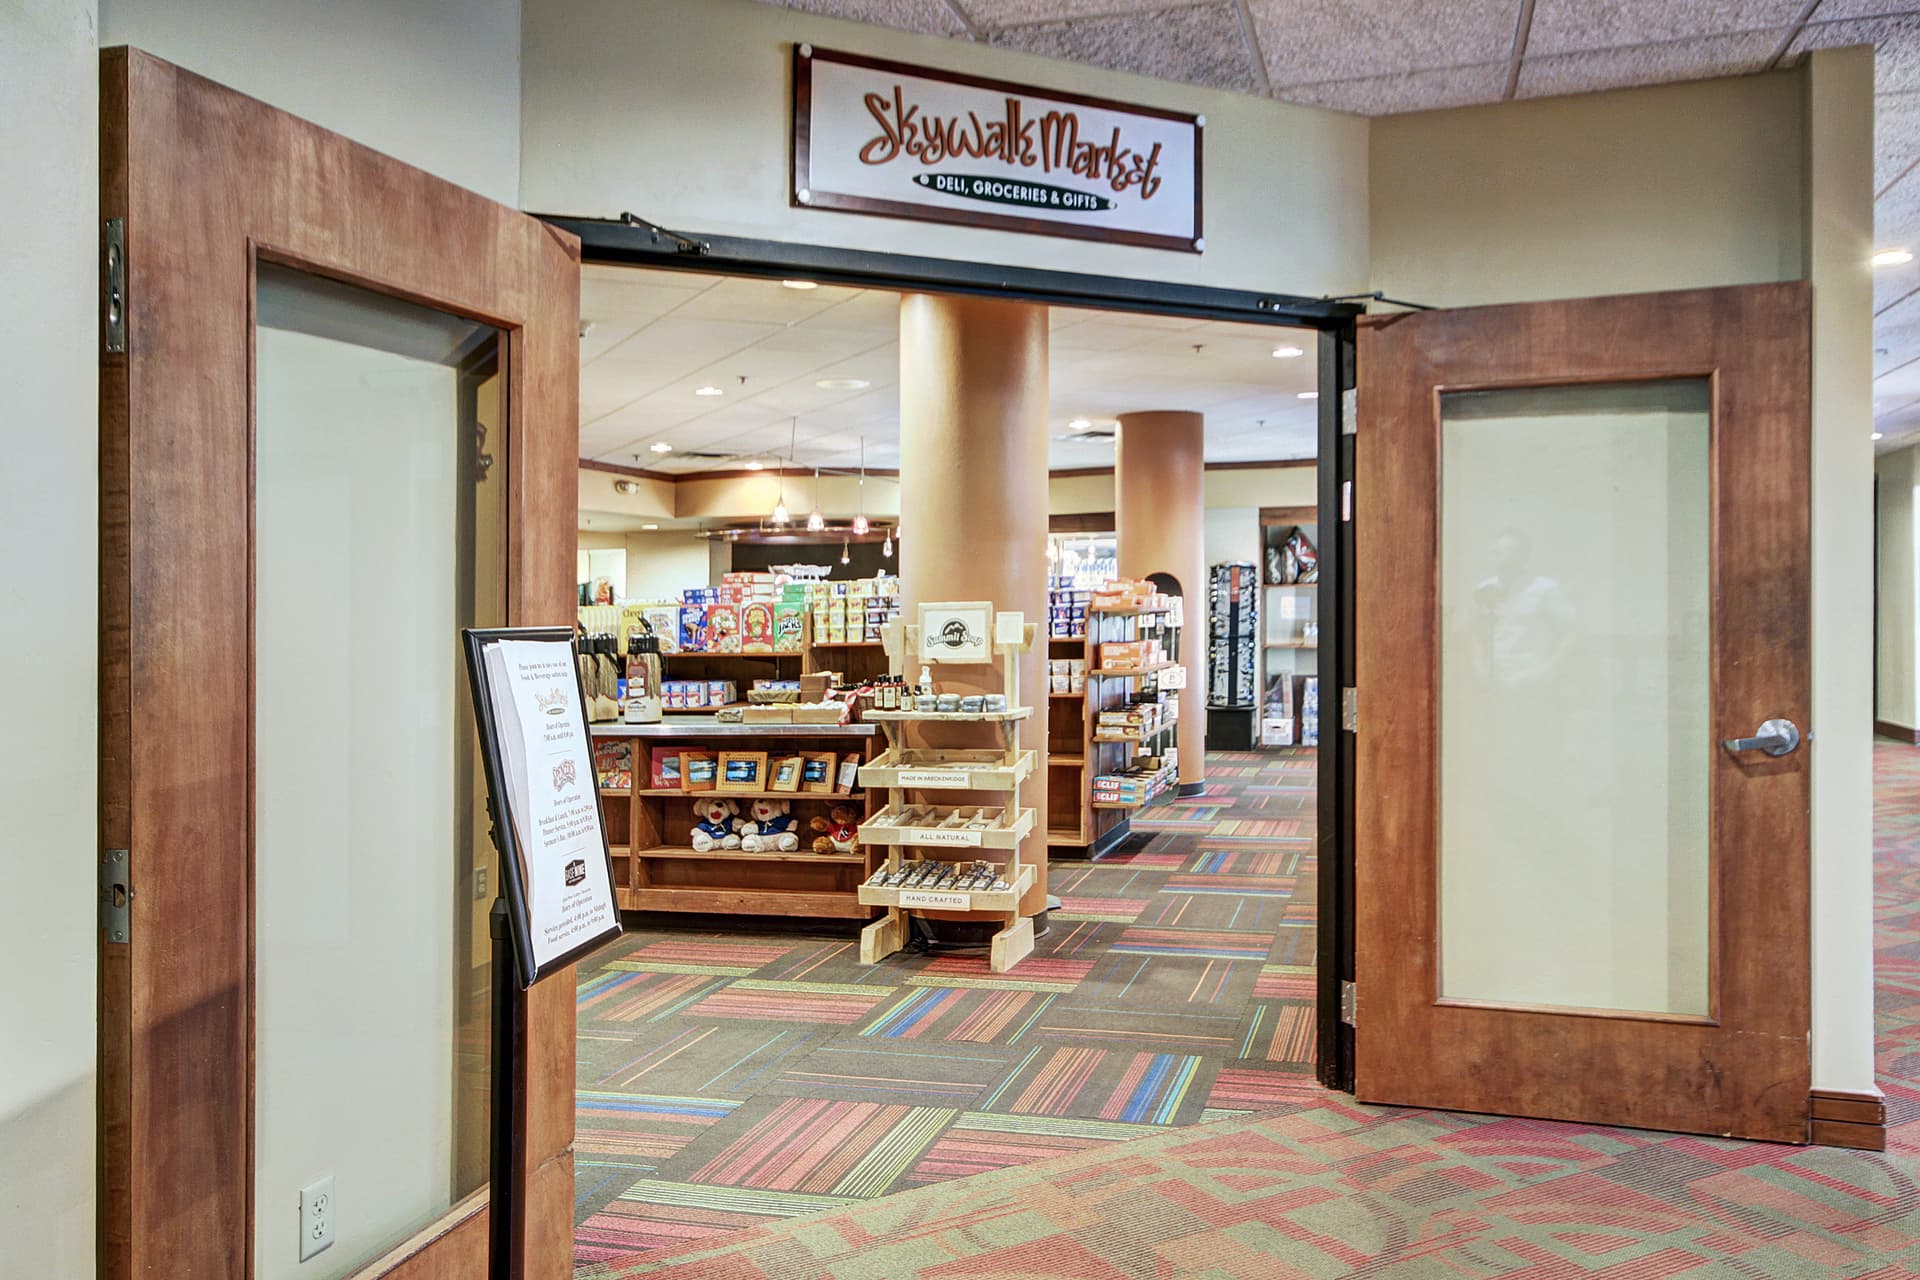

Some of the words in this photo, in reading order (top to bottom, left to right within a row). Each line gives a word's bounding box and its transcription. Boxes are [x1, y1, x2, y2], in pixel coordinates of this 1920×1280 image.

[1040, 111, 1163, 200] Market
[936, 175, 969, 195] DELI,
[972, 180, 1048, 203] GROCERIES
[1050, 190, 1060, 205] &
[1062, 192, 1098, 209] GIFTS
[928, 896, 963, 904] CRAFTED
